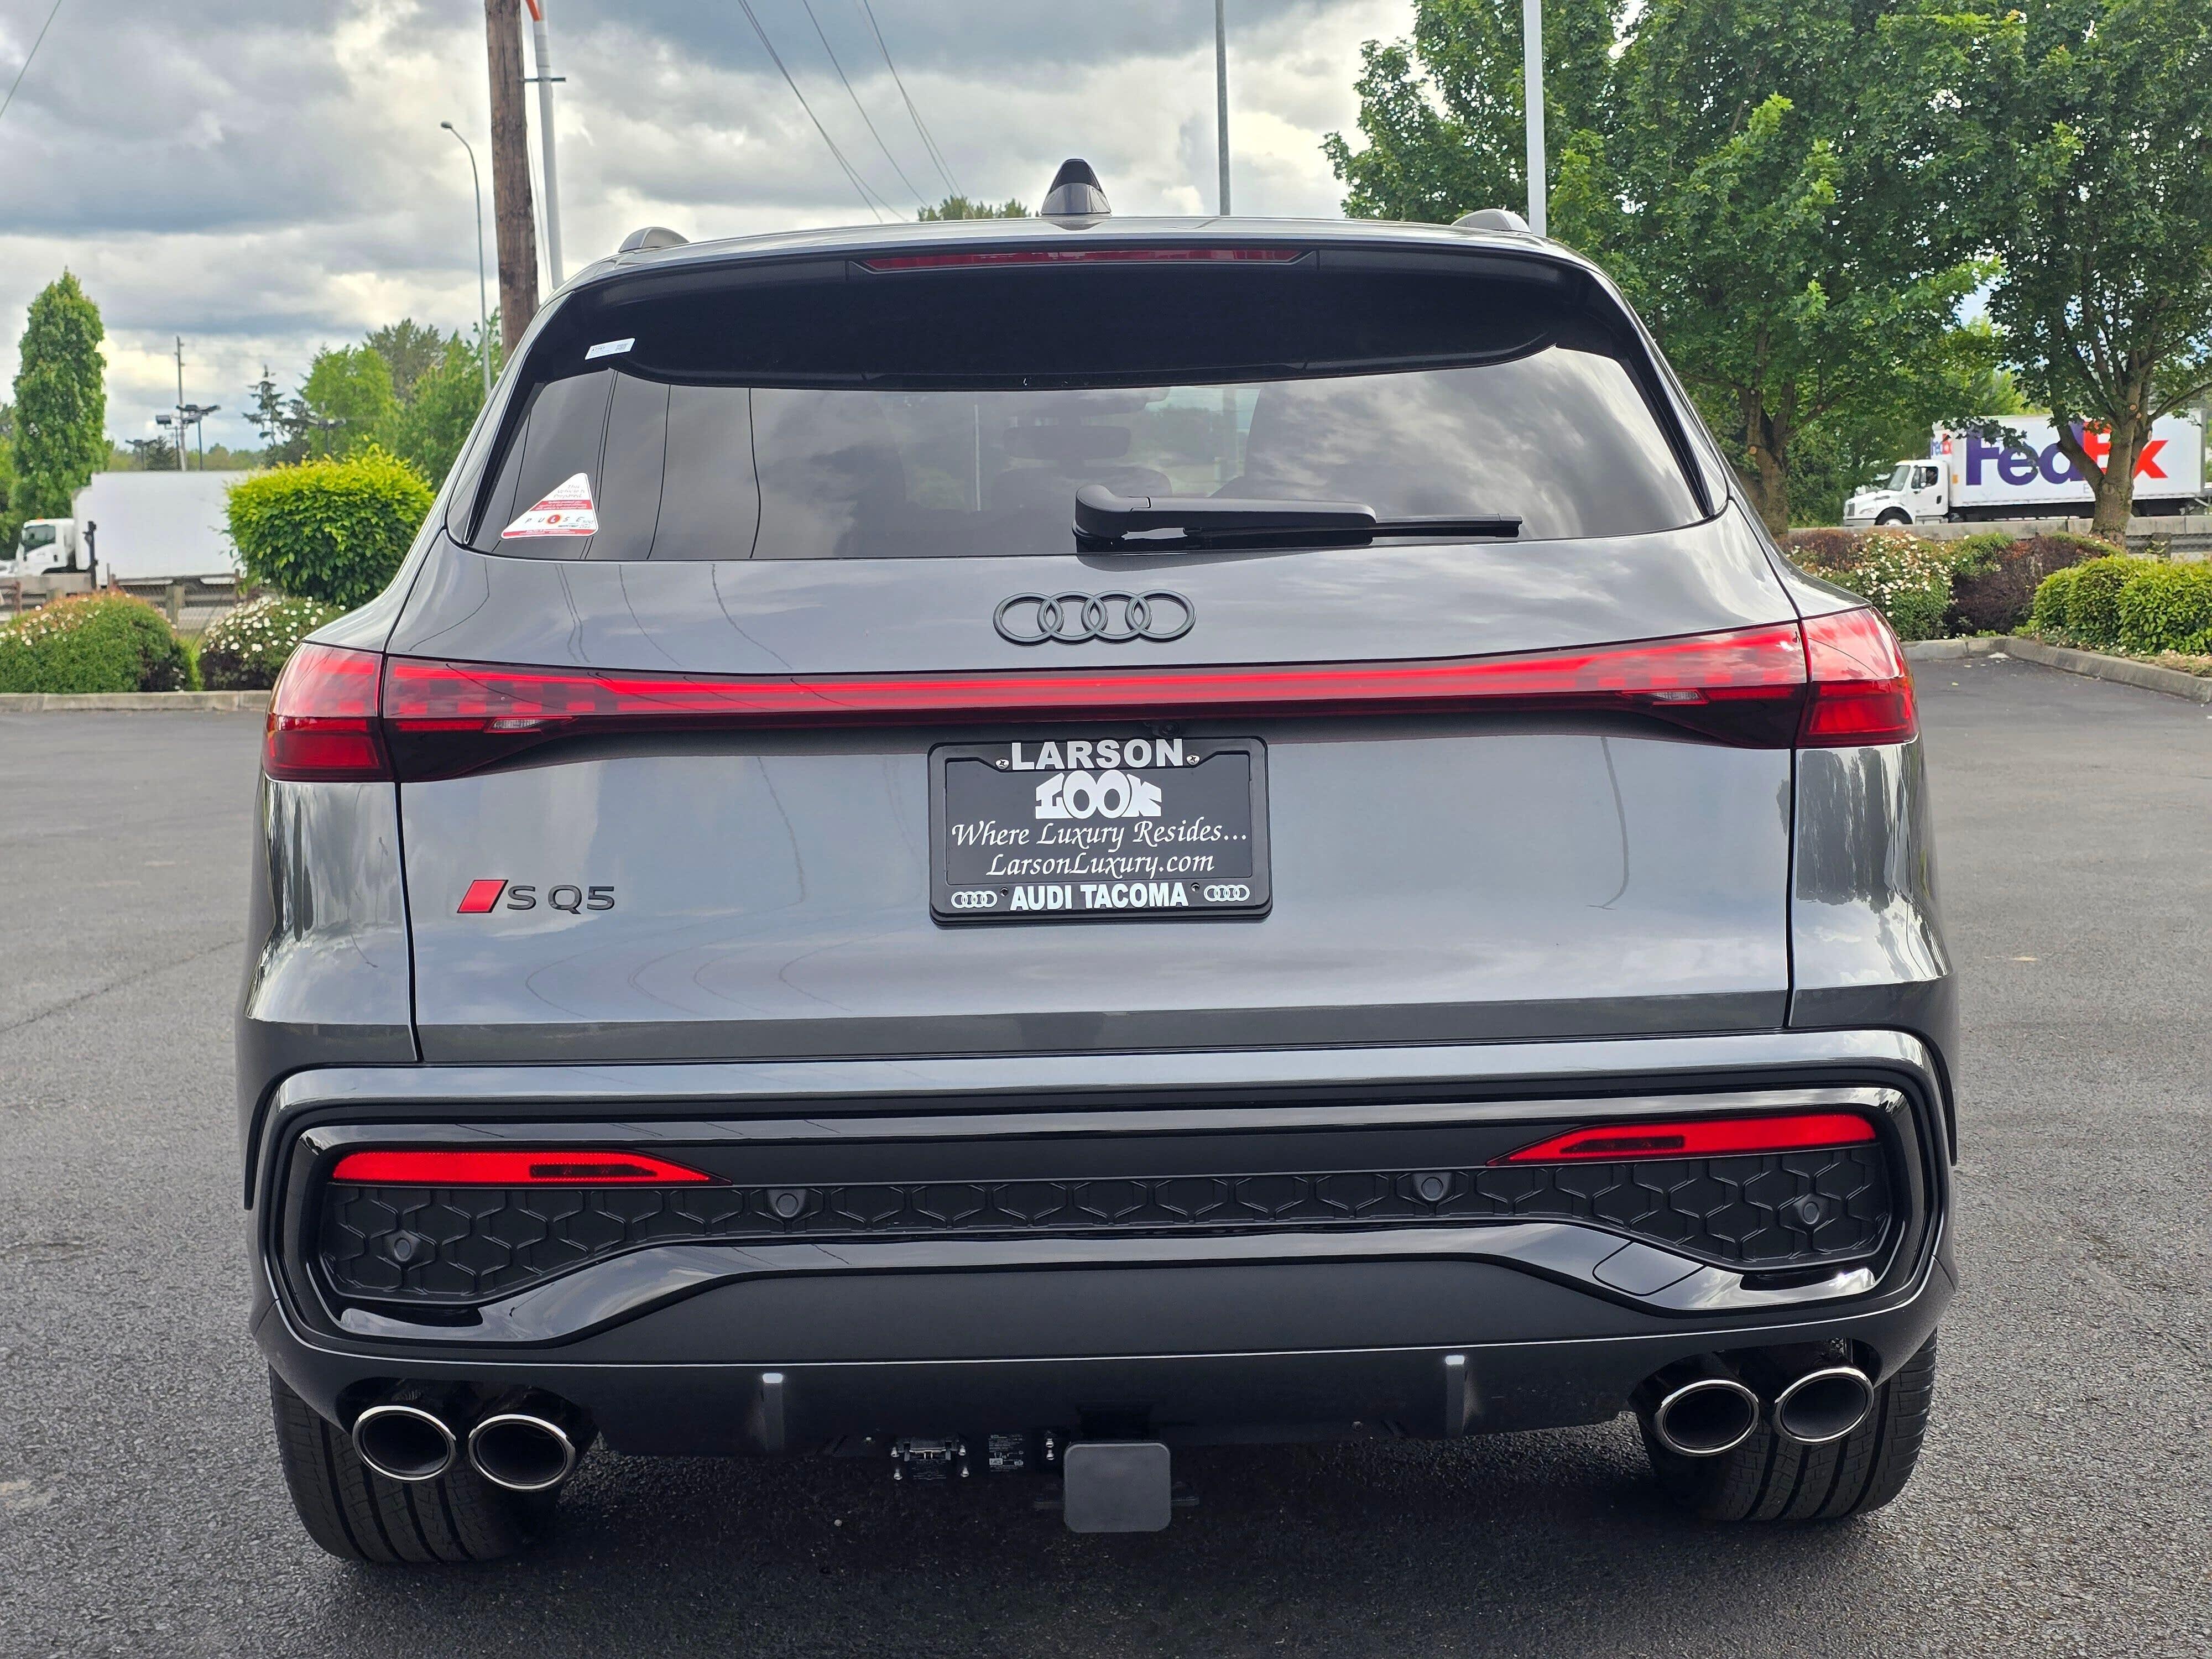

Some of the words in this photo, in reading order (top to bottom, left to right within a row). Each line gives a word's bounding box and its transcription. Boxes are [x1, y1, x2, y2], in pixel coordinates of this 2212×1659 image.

[1011, 739, 1183, 770] LARSON
[1035, 770, 1162, 820] LOOK
[951, 821, 1030, 846] Where
[1036, 822, 1125, 852] Luxury
[1133, 817, 1247, 847] Resides...
[985, 852, 1215, 879] LarsonLuxury.com
[1010, 885, 1072, 911] AUDI
[1080, 883, 1189, 909] TACOMA
